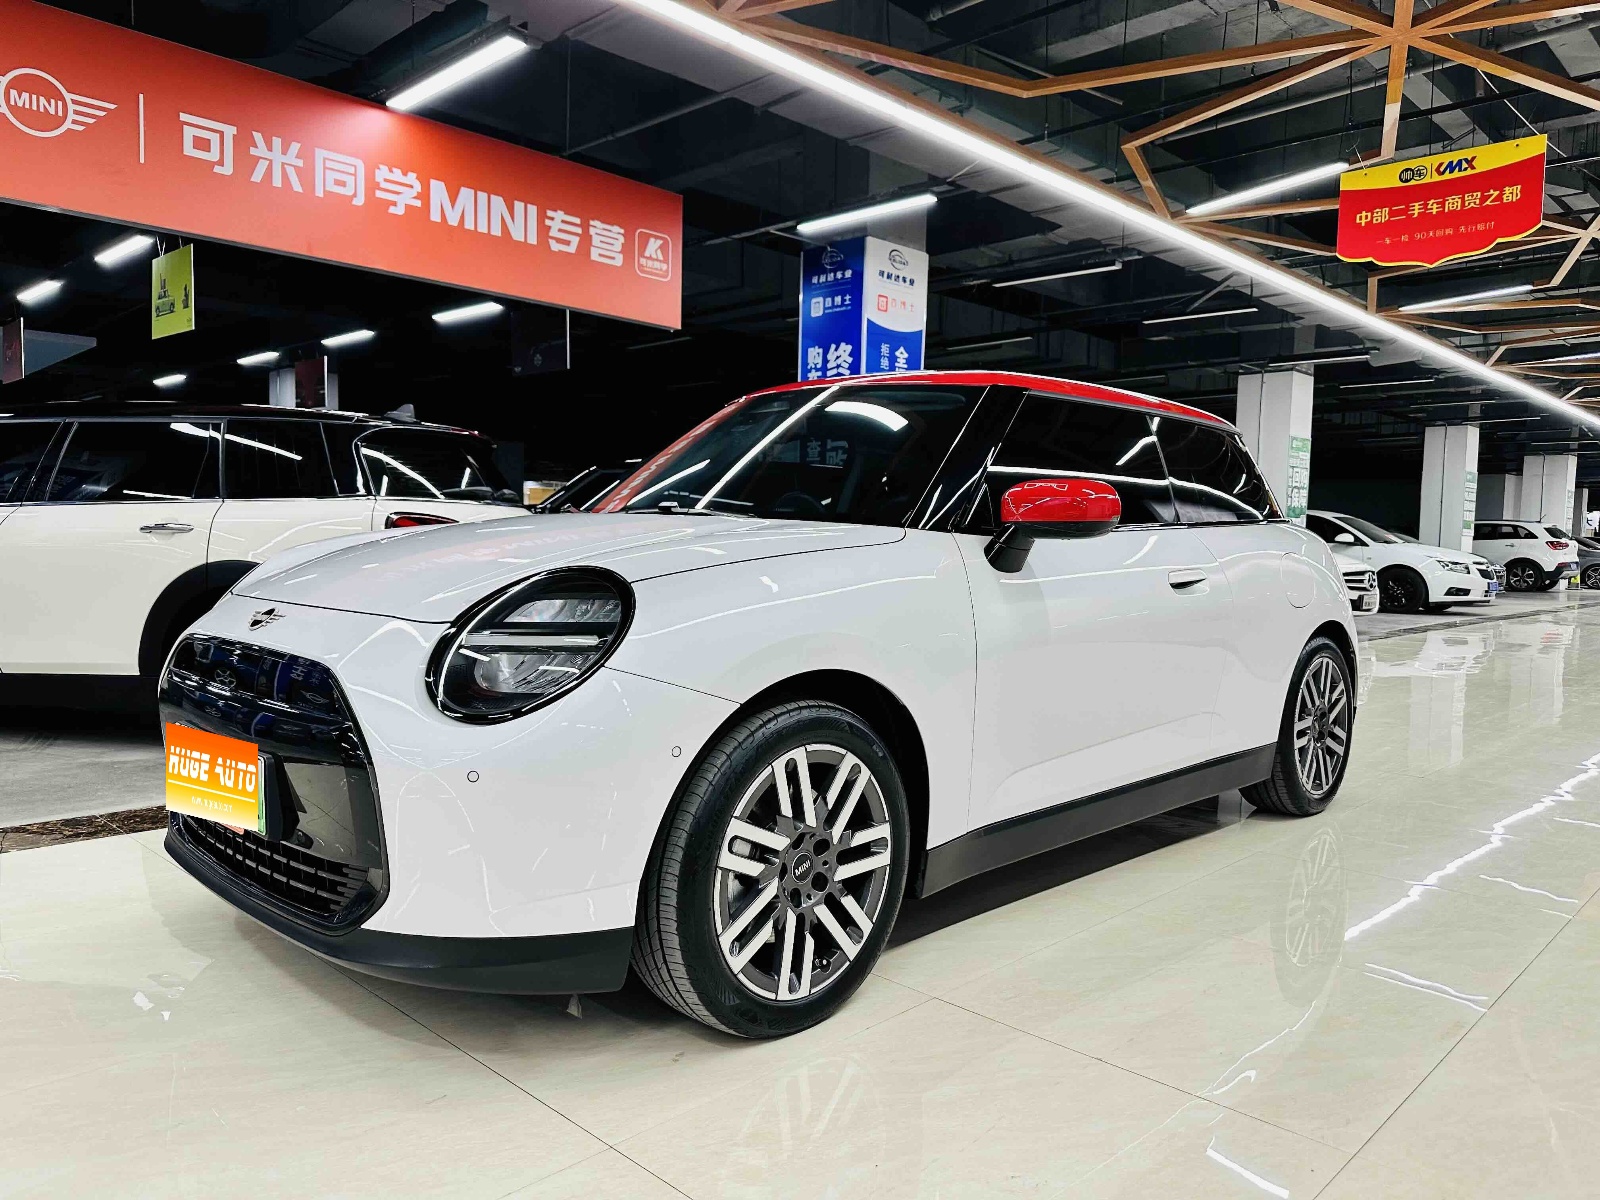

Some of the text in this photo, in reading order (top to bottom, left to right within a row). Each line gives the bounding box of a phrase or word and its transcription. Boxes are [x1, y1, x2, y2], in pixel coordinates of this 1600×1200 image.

[9, 88, 63, 117] MINI
[179, 112, 625, 268] 可米同学MINI专营
[1355, 184, 1522, 227] 中部二手车商贸之都
[1414, 228, 1454, 241] 90天回购
[1459, 221, 1495, 234] 先行赔付
[795, 859, 811, 877] MINI
